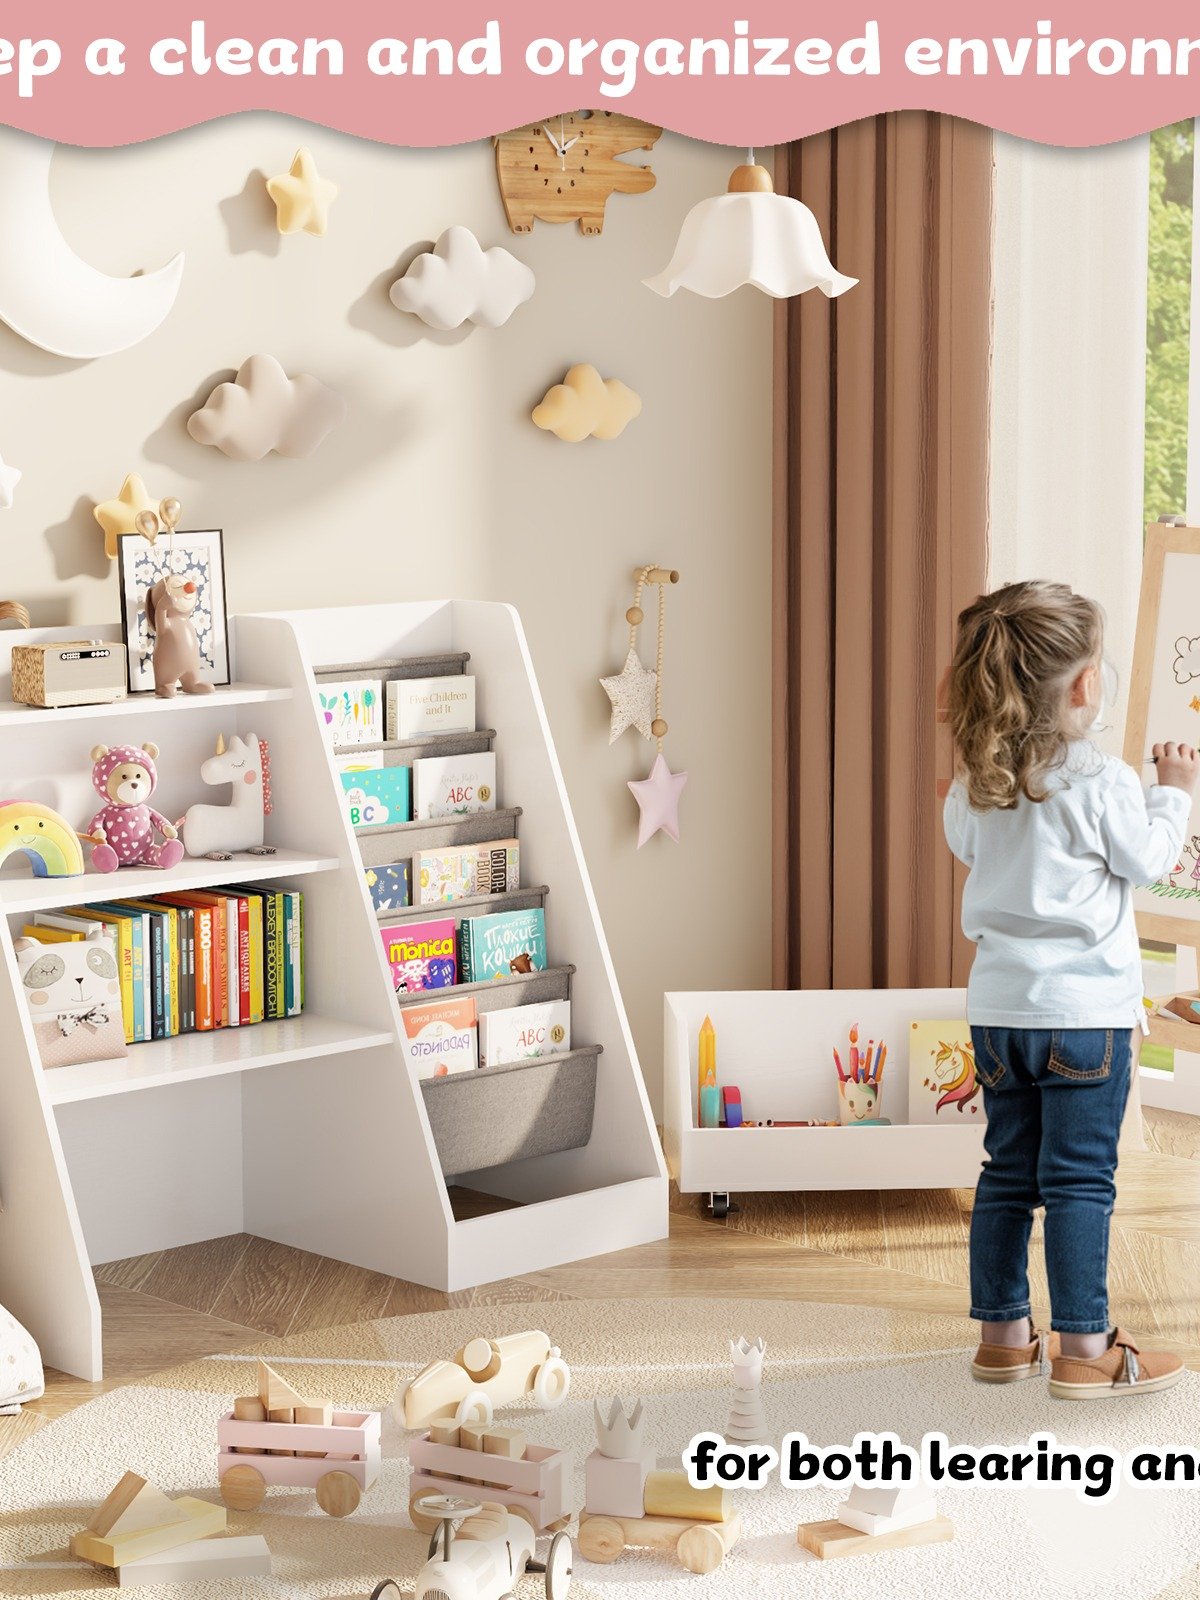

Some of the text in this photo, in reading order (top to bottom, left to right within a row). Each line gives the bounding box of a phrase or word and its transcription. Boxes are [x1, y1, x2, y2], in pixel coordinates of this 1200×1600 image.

[409, 691, 468, 705] Five Children
[425, 704, 443, 716] and
[445, 786, 474, 804] ABC
[476, 859, 491, 892] BOOK
[267, 894, 276, 937] ALEXEY
[200, 912, 212, 950] 1000
[124, 948, 132, 968] ART
[516, 1027, 546, 1047] ABC
